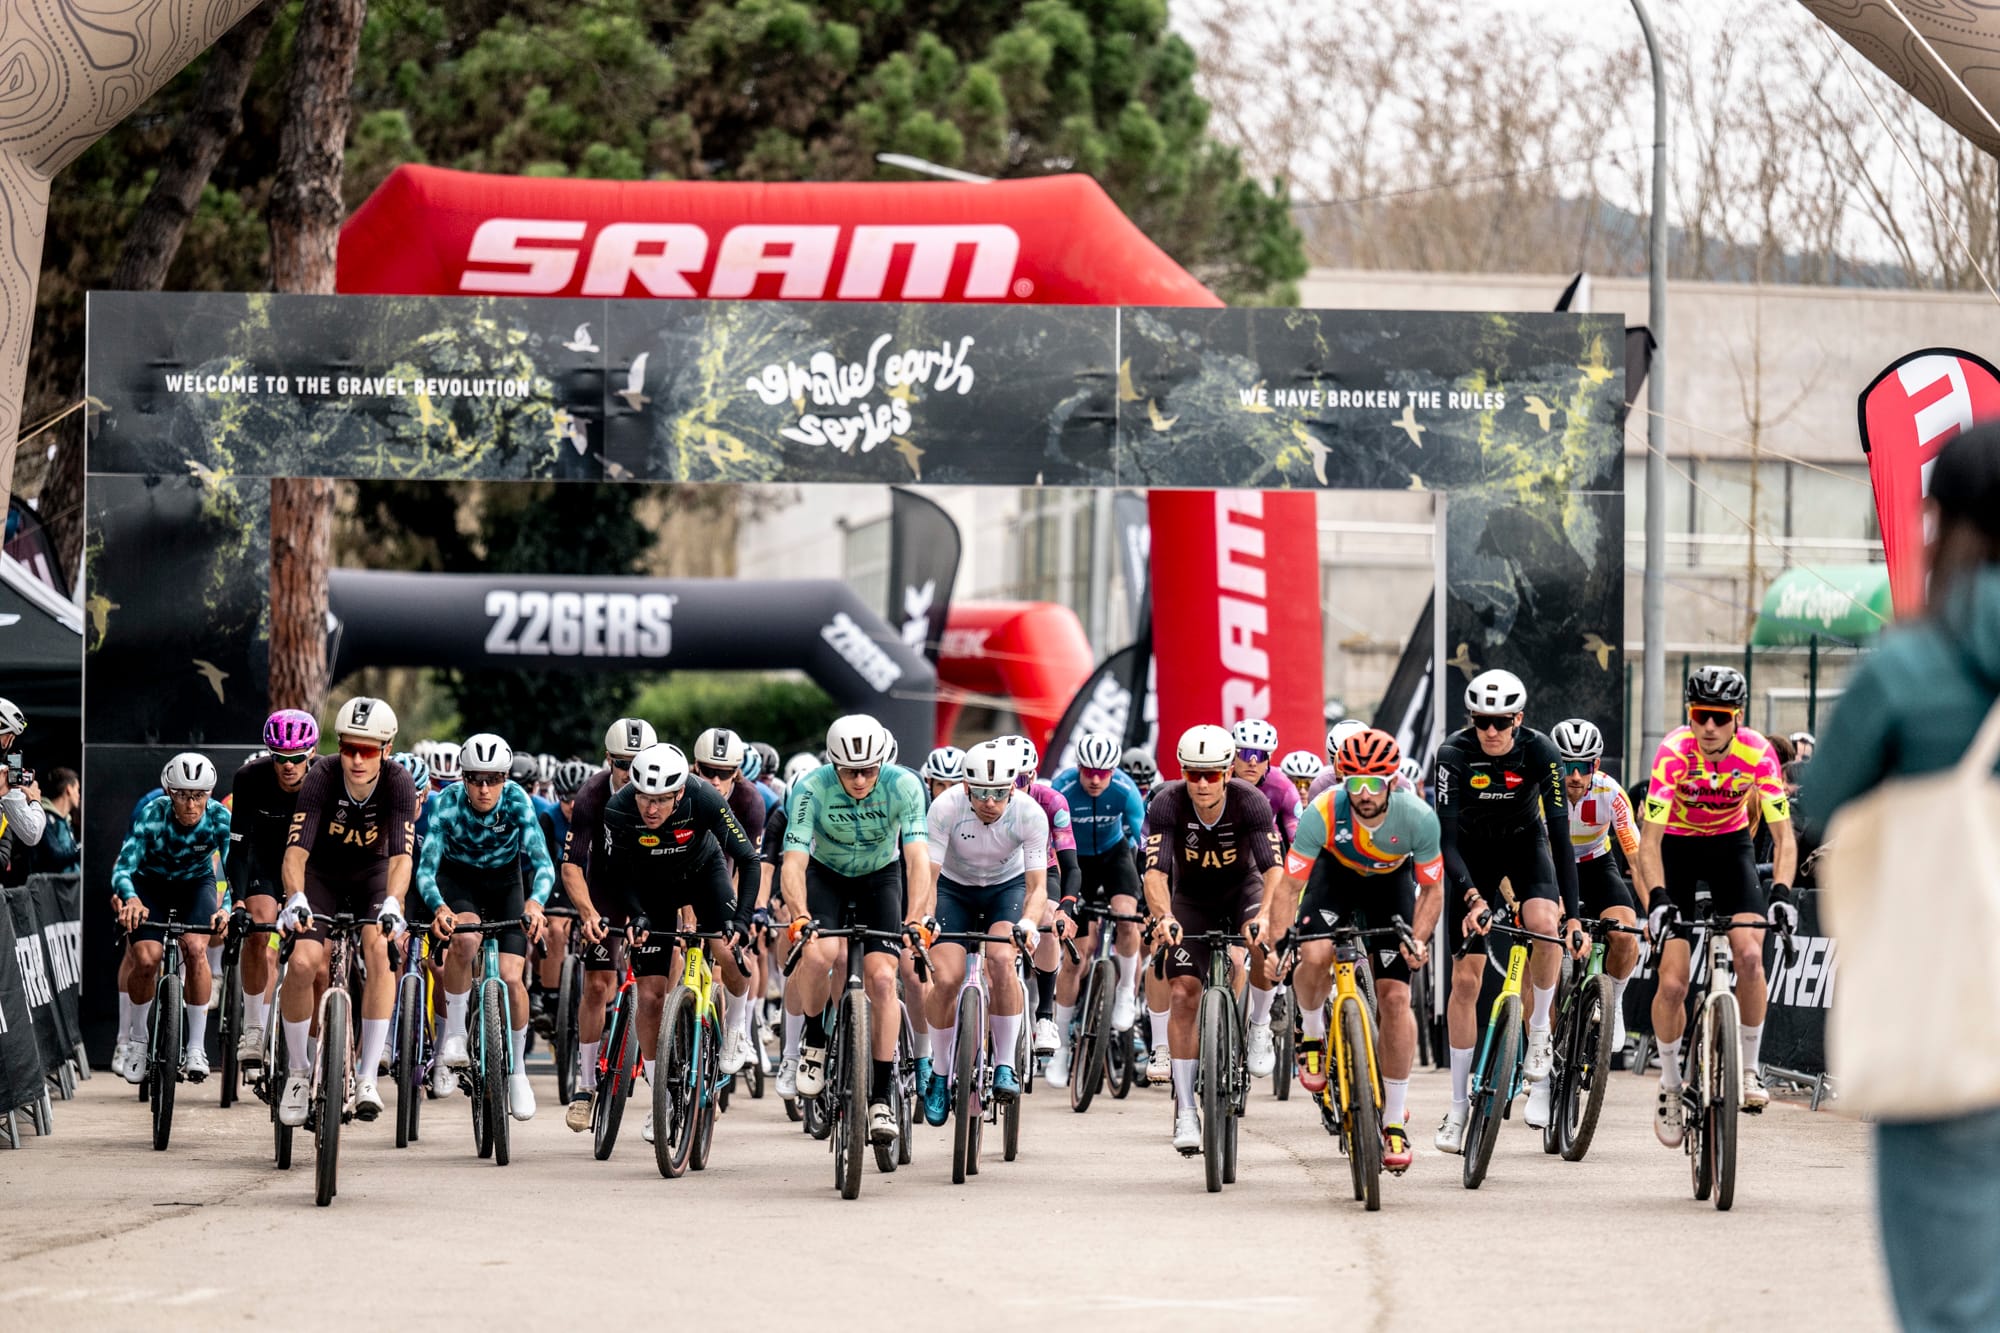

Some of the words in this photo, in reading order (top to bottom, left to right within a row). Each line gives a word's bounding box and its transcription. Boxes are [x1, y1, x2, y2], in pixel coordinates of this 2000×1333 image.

[460, 218, 1020, 299] SRAM
[884, 335, 976, 395] earth
[165, 374, 258, 394] WELCOME
[265, 375, 288, 395] TO
[295, 376, 331, 395] THE
[337, 377, 407, 397] GRAVEL
[413, 378, 530, 398] REVOLUTION
[1239, 389, 1268, 407] WE
[1274, 389, 1321, 408] HAVE
[1327, 390, 1401, 409] BROKEN
[1407, 391, 1442, 409] THE
[1449, 391, 1506, 410] RULES
[779, 397, 912, 452] series
[484, 590, 675, 658] 226ERS
[1438, 764, 1450, 806] BMC
[1479, 792, 1516, 800] BMC
[828, 809, 888, 823] CANYON
[328, 821, 379, 847] PAS
[651, 845, 688, 856] BMC
[1185, 847, 1238, 869] PAS
[688, 953, 698, 978] BMC
[1510, 954, 1521, 983] BMC
